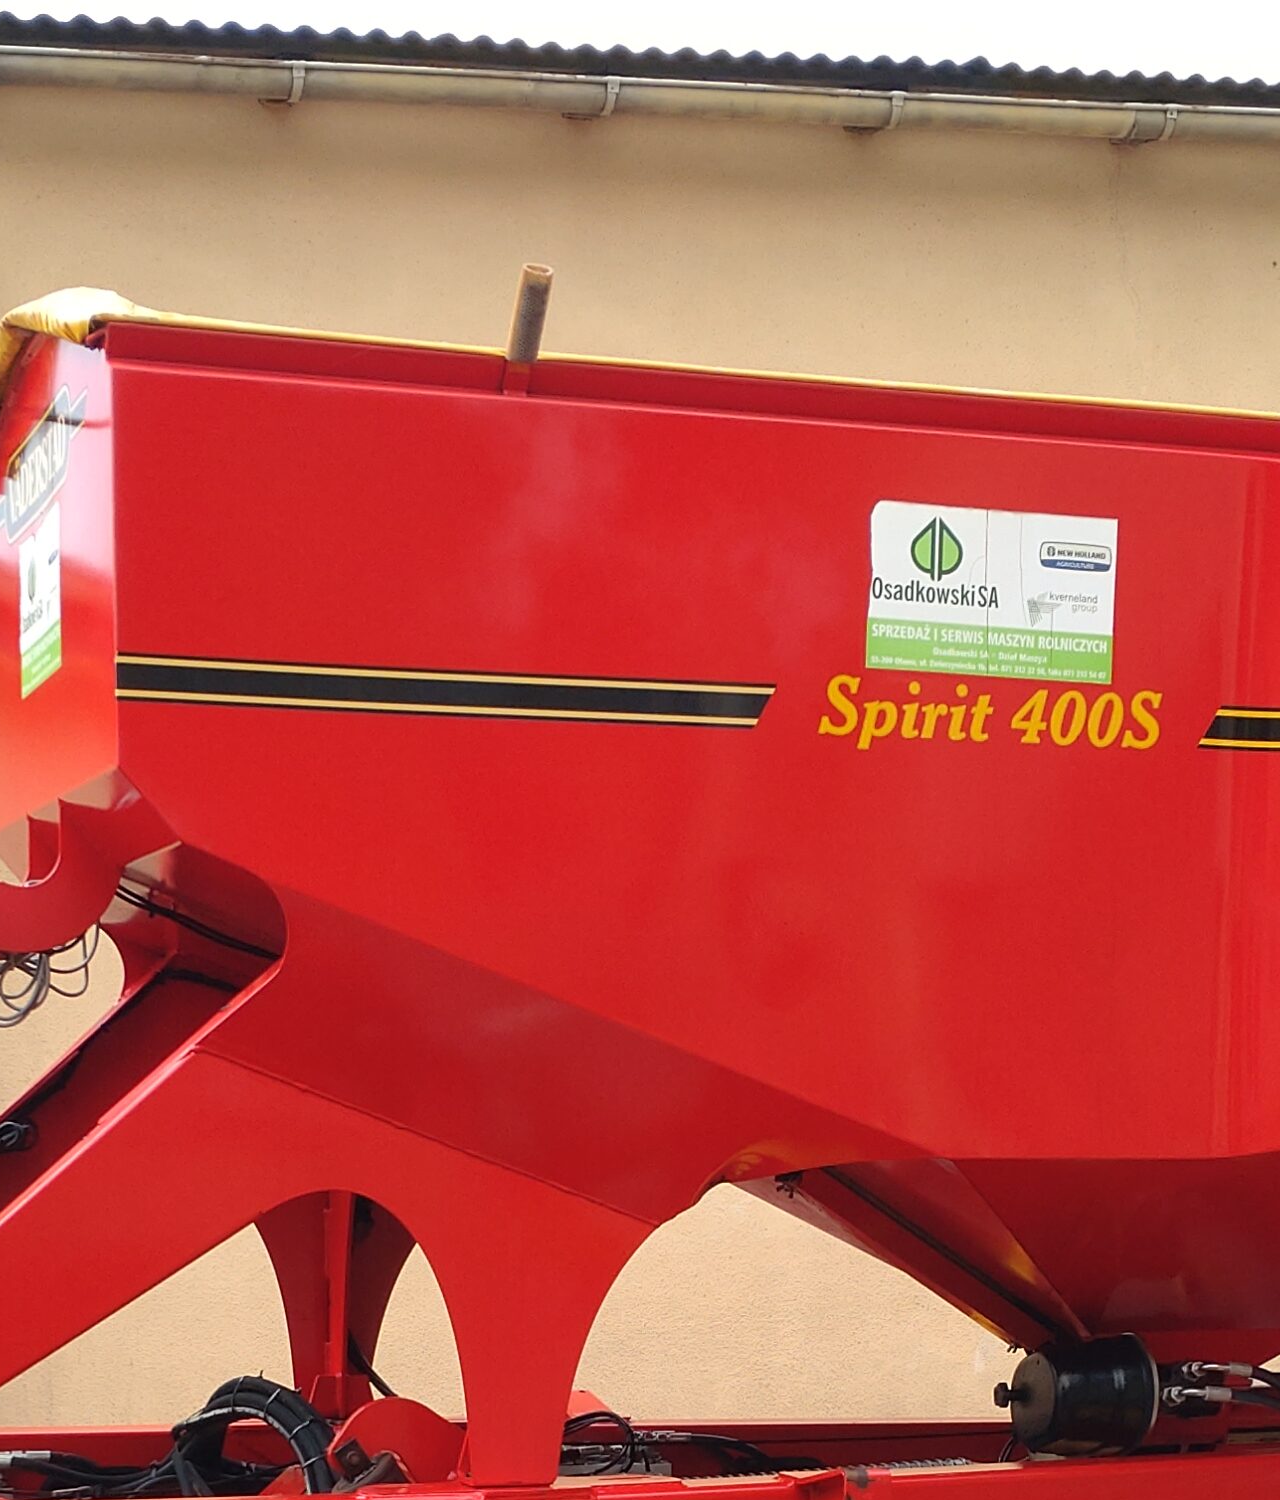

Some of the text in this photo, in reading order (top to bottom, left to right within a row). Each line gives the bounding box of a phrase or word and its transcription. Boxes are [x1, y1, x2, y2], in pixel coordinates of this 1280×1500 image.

[7, 413, 66, 524] VÄDERSTAD
[1057, 549, 1106, 560] NEW HOLLAND
[1049, 591, 1099, 604] kverneland
[1071, 603, 1098, 614] group
[871, 622, 931, 641] SPRZEDAŻ
[940, 628, 985, 645] SERWIS
[987, 631, 1035, 649] MASZYN
[1038, 635, 1108, 654] ROLNICZYCH
[818, 673, 1164, 751] Spirit 400S
